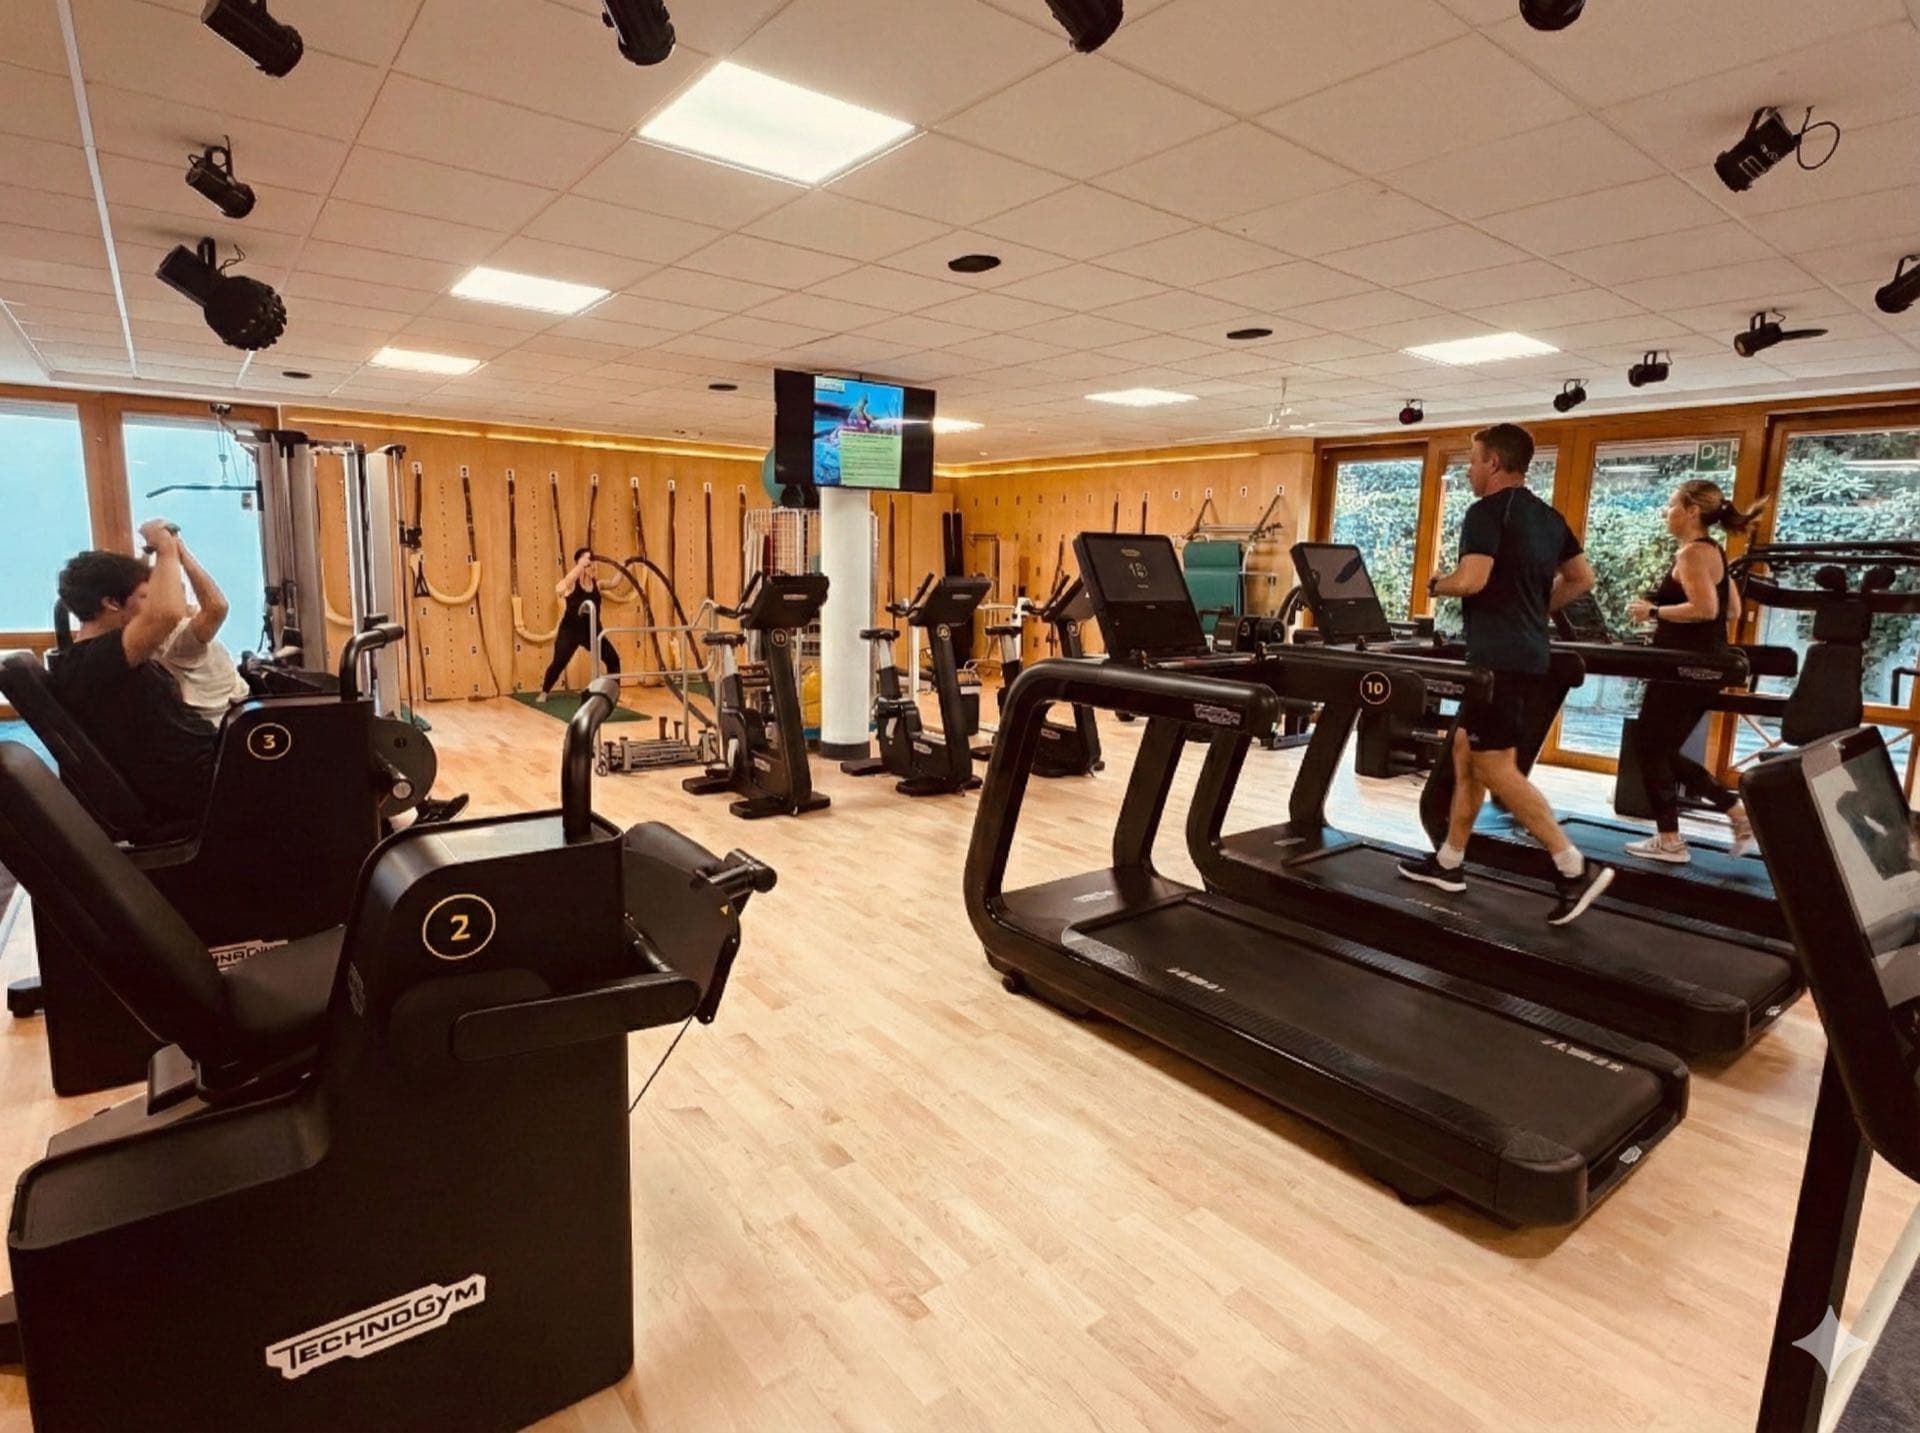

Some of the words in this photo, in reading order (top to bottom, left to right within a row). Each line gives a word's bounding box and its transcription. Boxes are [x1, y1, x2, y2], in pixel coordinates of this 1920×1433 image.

[1366, 681, 1383, 695] 10
[263, 734, 276, 750] 3
[450, 914, 471, 941] 2
[272, 1281, 478, 1370] TECHNOGYM
